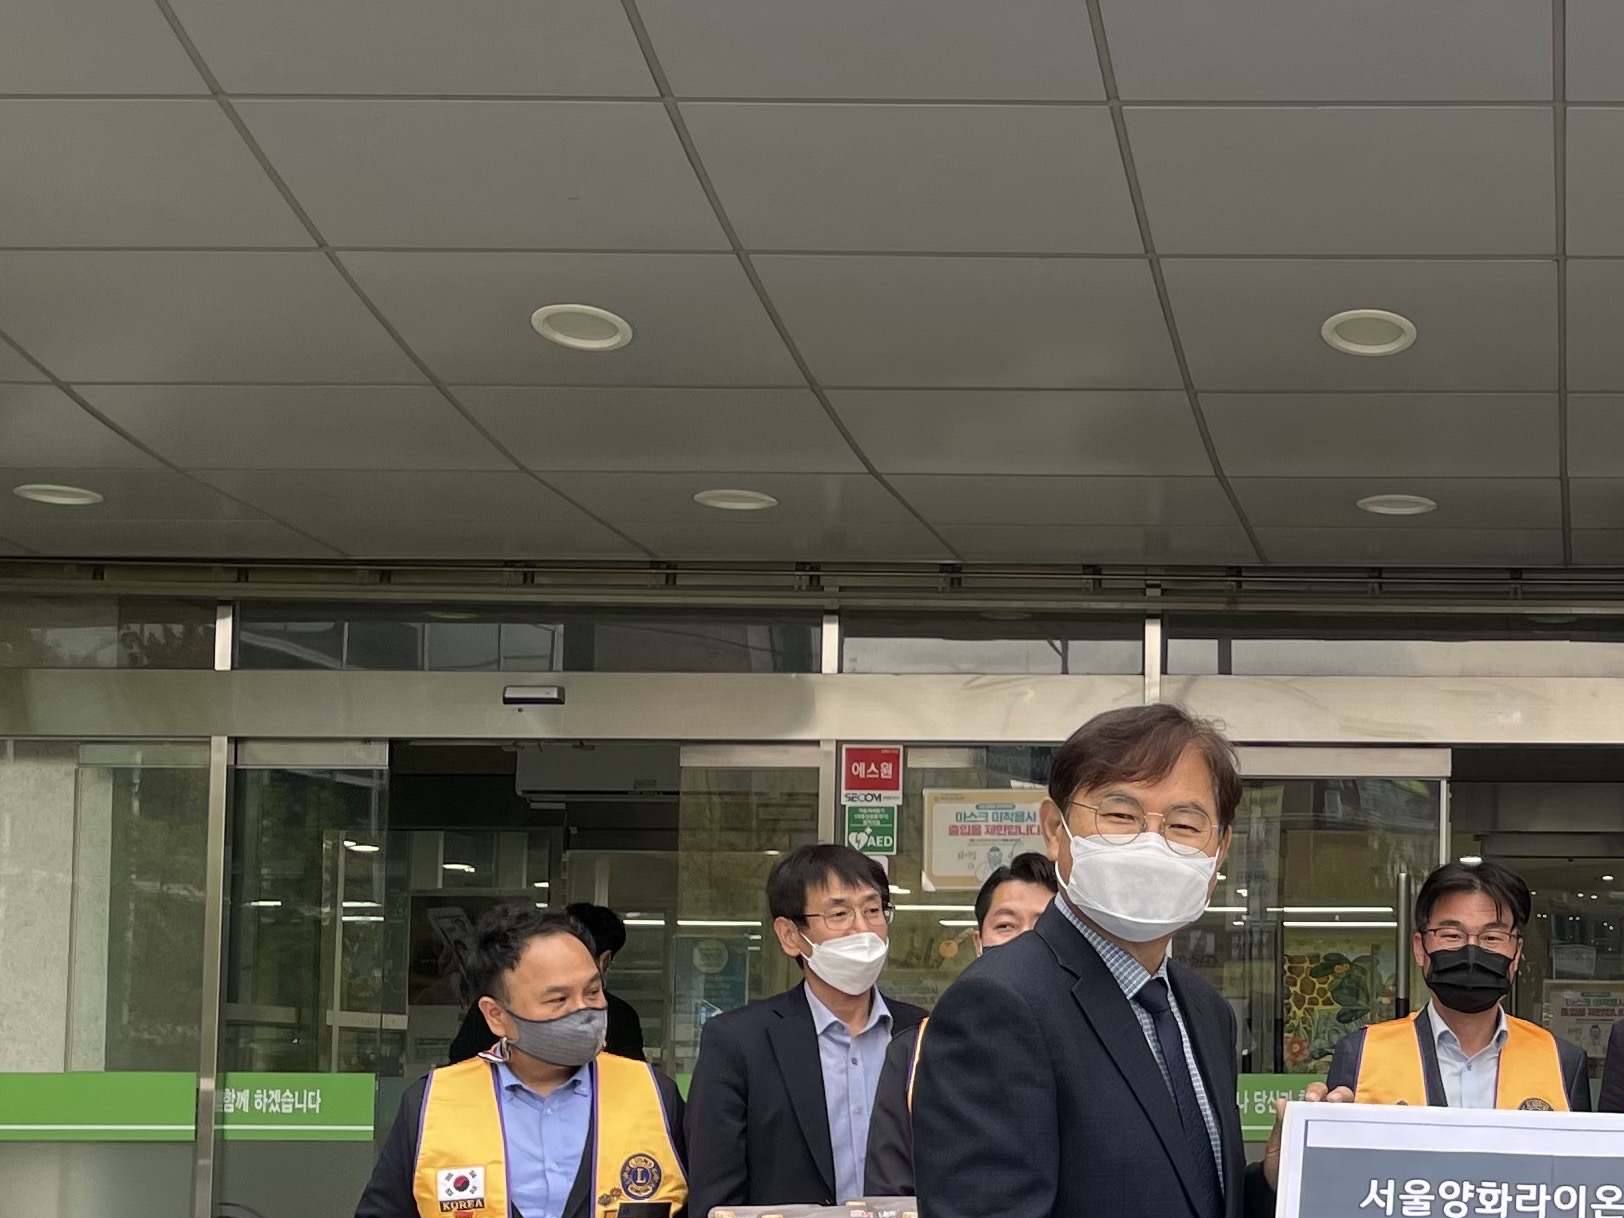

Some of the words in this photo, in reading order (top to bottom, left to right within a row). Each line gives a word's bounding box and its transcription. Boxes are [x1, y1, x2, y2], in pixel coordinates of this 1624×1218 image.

[851, 762, 893, 779] 에스원
[844, 793, 882, 803] SECOM
[955, 811, 989, 823] 마스크
[867, 835, 893, 848] AED
[223, 1089, 249, 1113] 함께
[254, 1089, 321, 1114] 하겠습니다
[442, 1199, 484, 1211] KOREA
